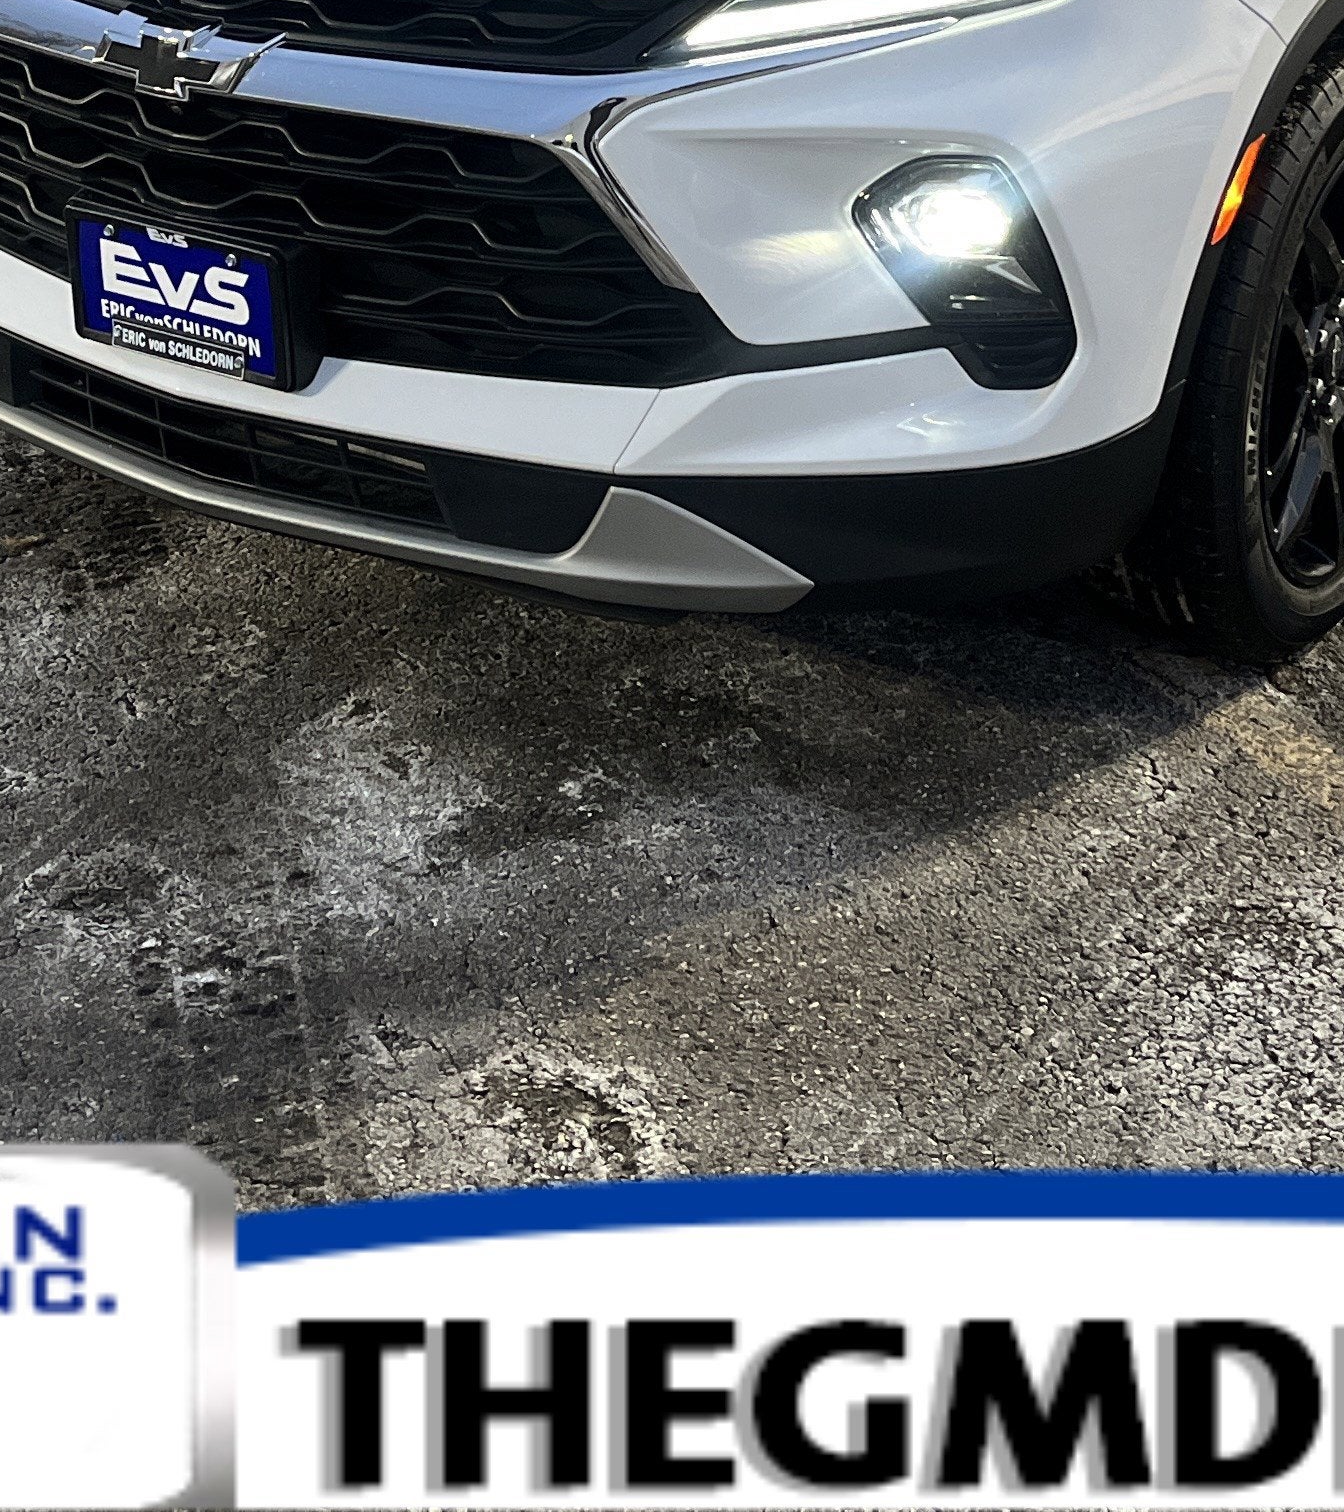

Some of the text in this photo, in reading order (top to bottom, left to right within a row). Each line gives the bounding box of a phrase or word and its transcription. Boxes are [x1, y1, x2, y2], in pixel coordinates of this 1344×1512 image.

[121, 326, 234, 371] ERIC von SCHLEDORN
